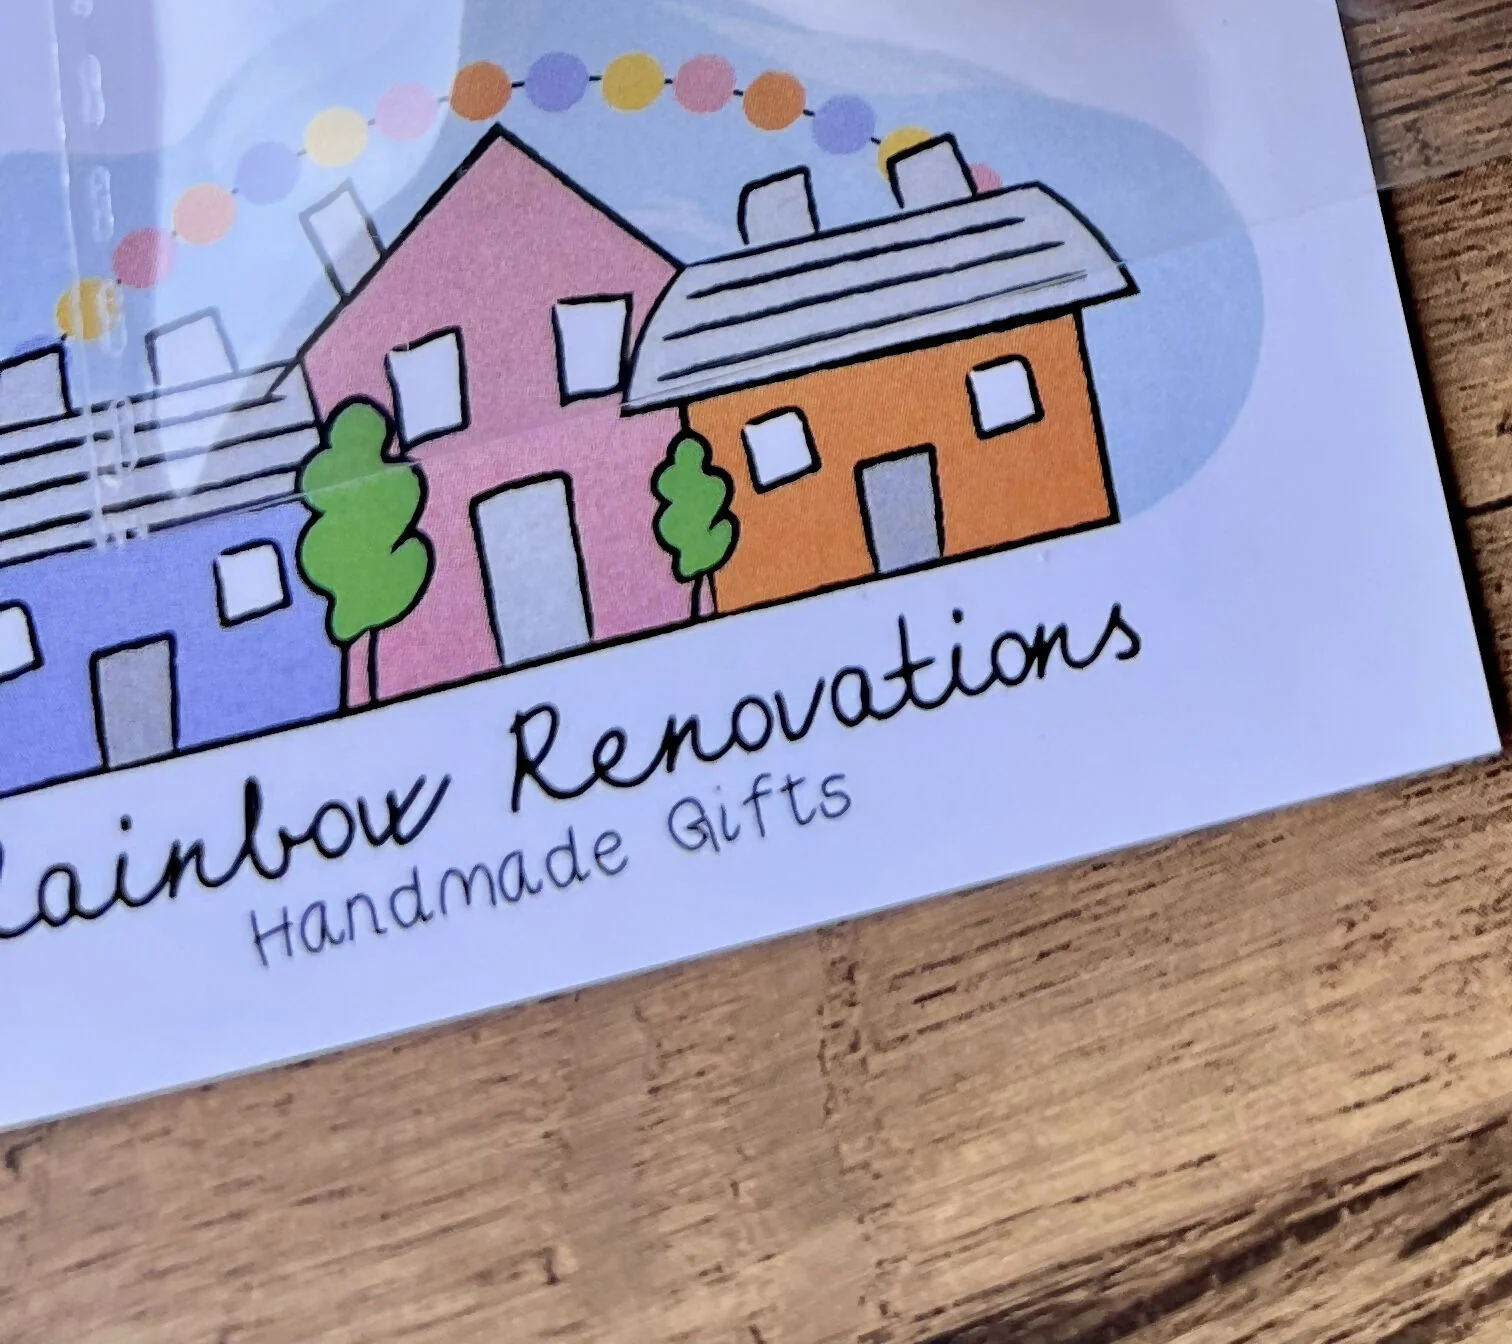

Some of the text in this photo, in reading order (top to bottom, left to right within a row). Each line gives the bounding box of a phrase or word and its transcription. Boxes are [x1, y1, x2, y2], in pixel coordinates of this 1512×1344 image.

[510, 602, 1142, 813] Renovations
[250, 771, 853, 968] Handmade Gifts
